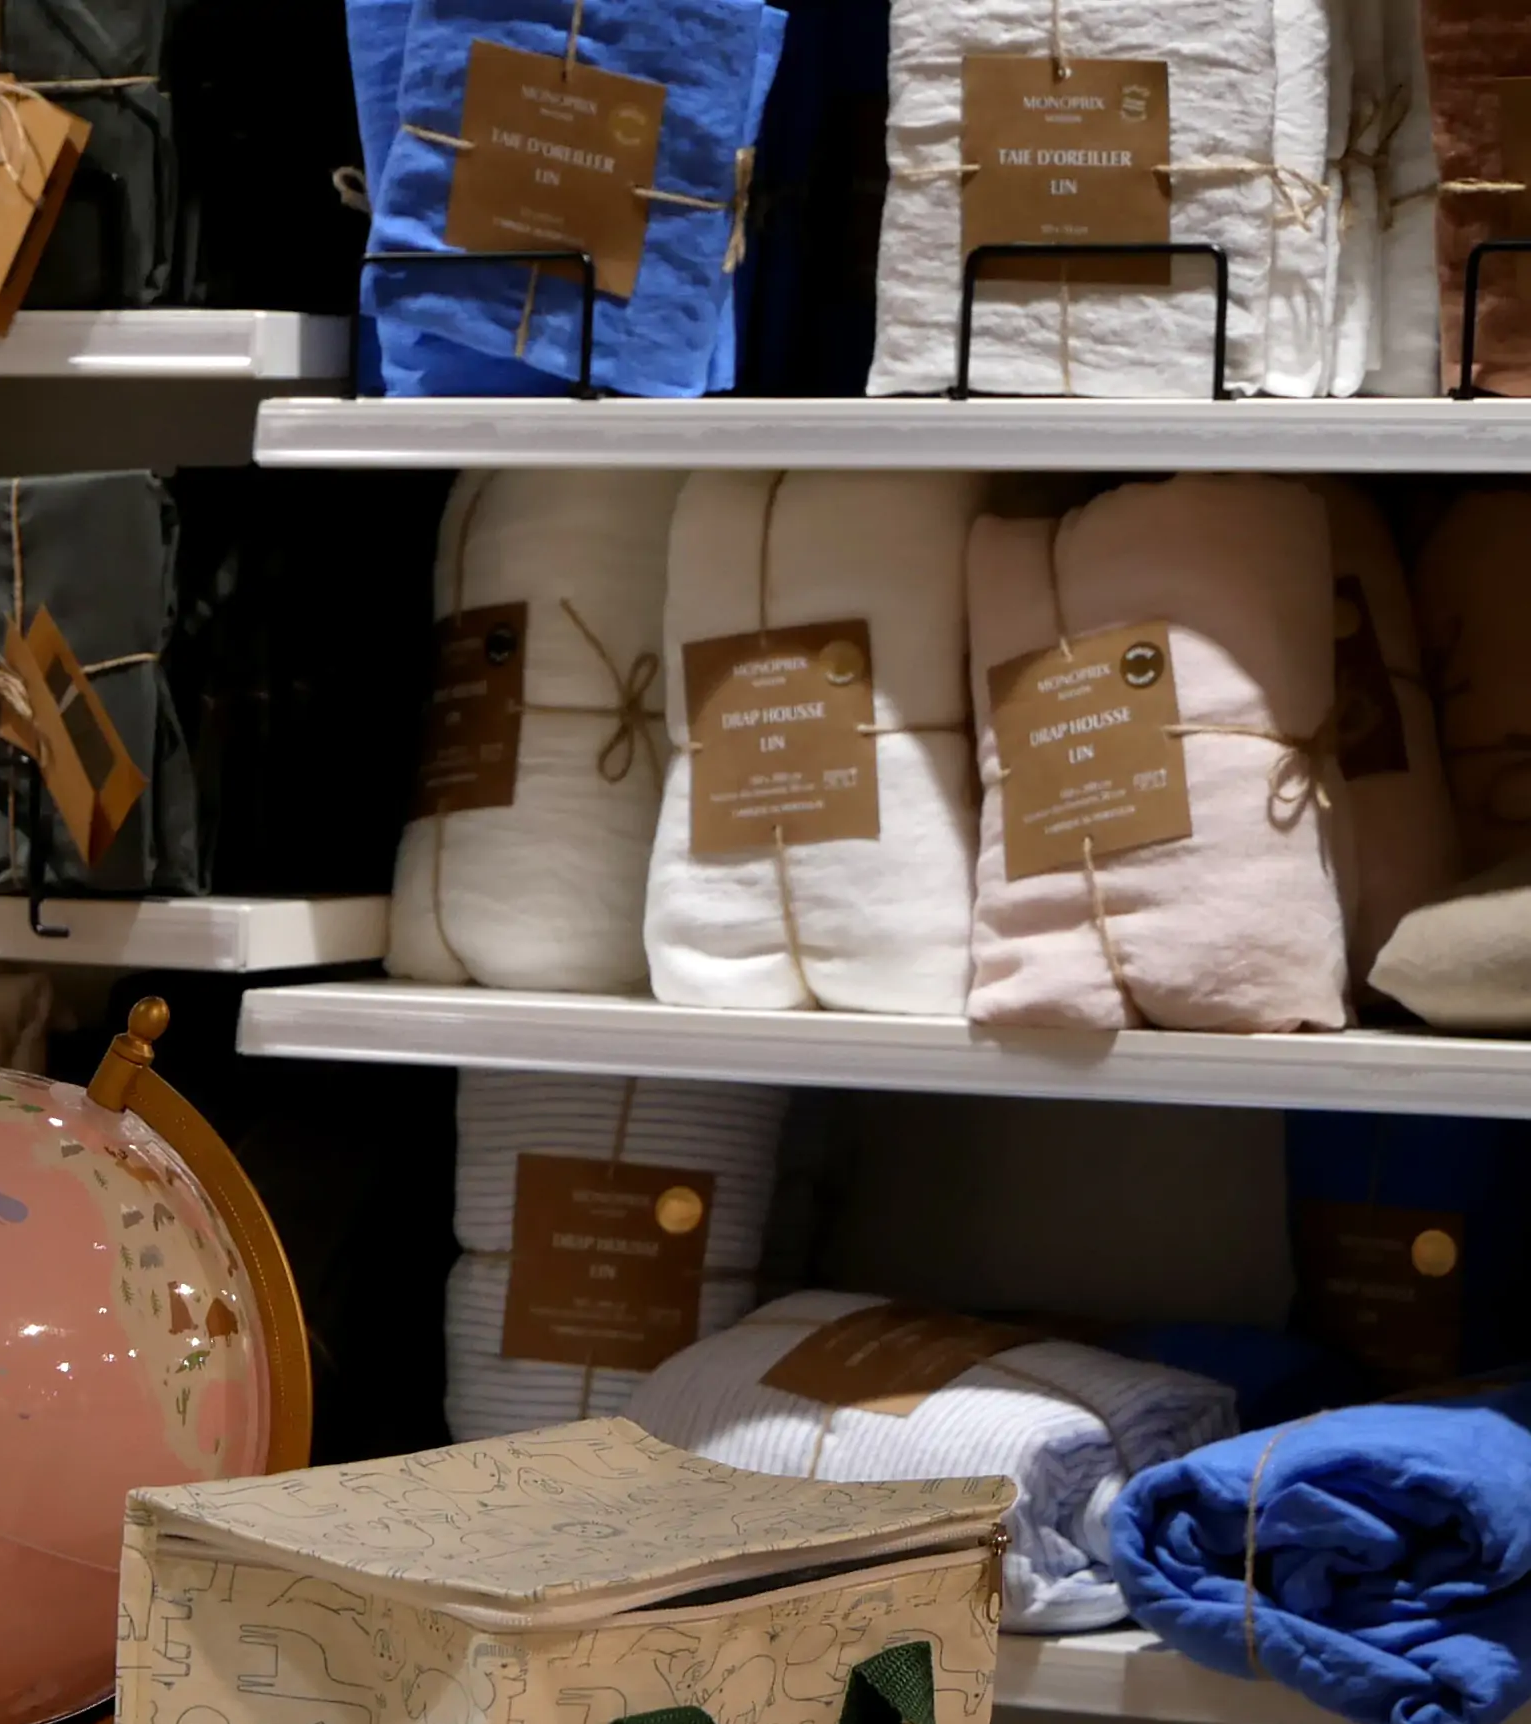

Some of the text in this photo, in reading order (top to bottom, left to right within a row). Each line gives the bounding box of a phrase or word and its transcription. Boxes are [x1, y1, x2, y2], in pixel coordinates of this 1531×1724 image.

[1023, 96, 1105, 111] MONOPRIX
[997, 149, 1133, 166] TAIE D'OREILLER
[1050, 179, 1078, 195] LIN
[721, 702, 826, 730] DRAP HOUSSE
[1029, 706, 1132, 748] DRAP HOUSSE
[760, 735, 787, 753] LIN
[1068, 745, 1094, 764] LIN
